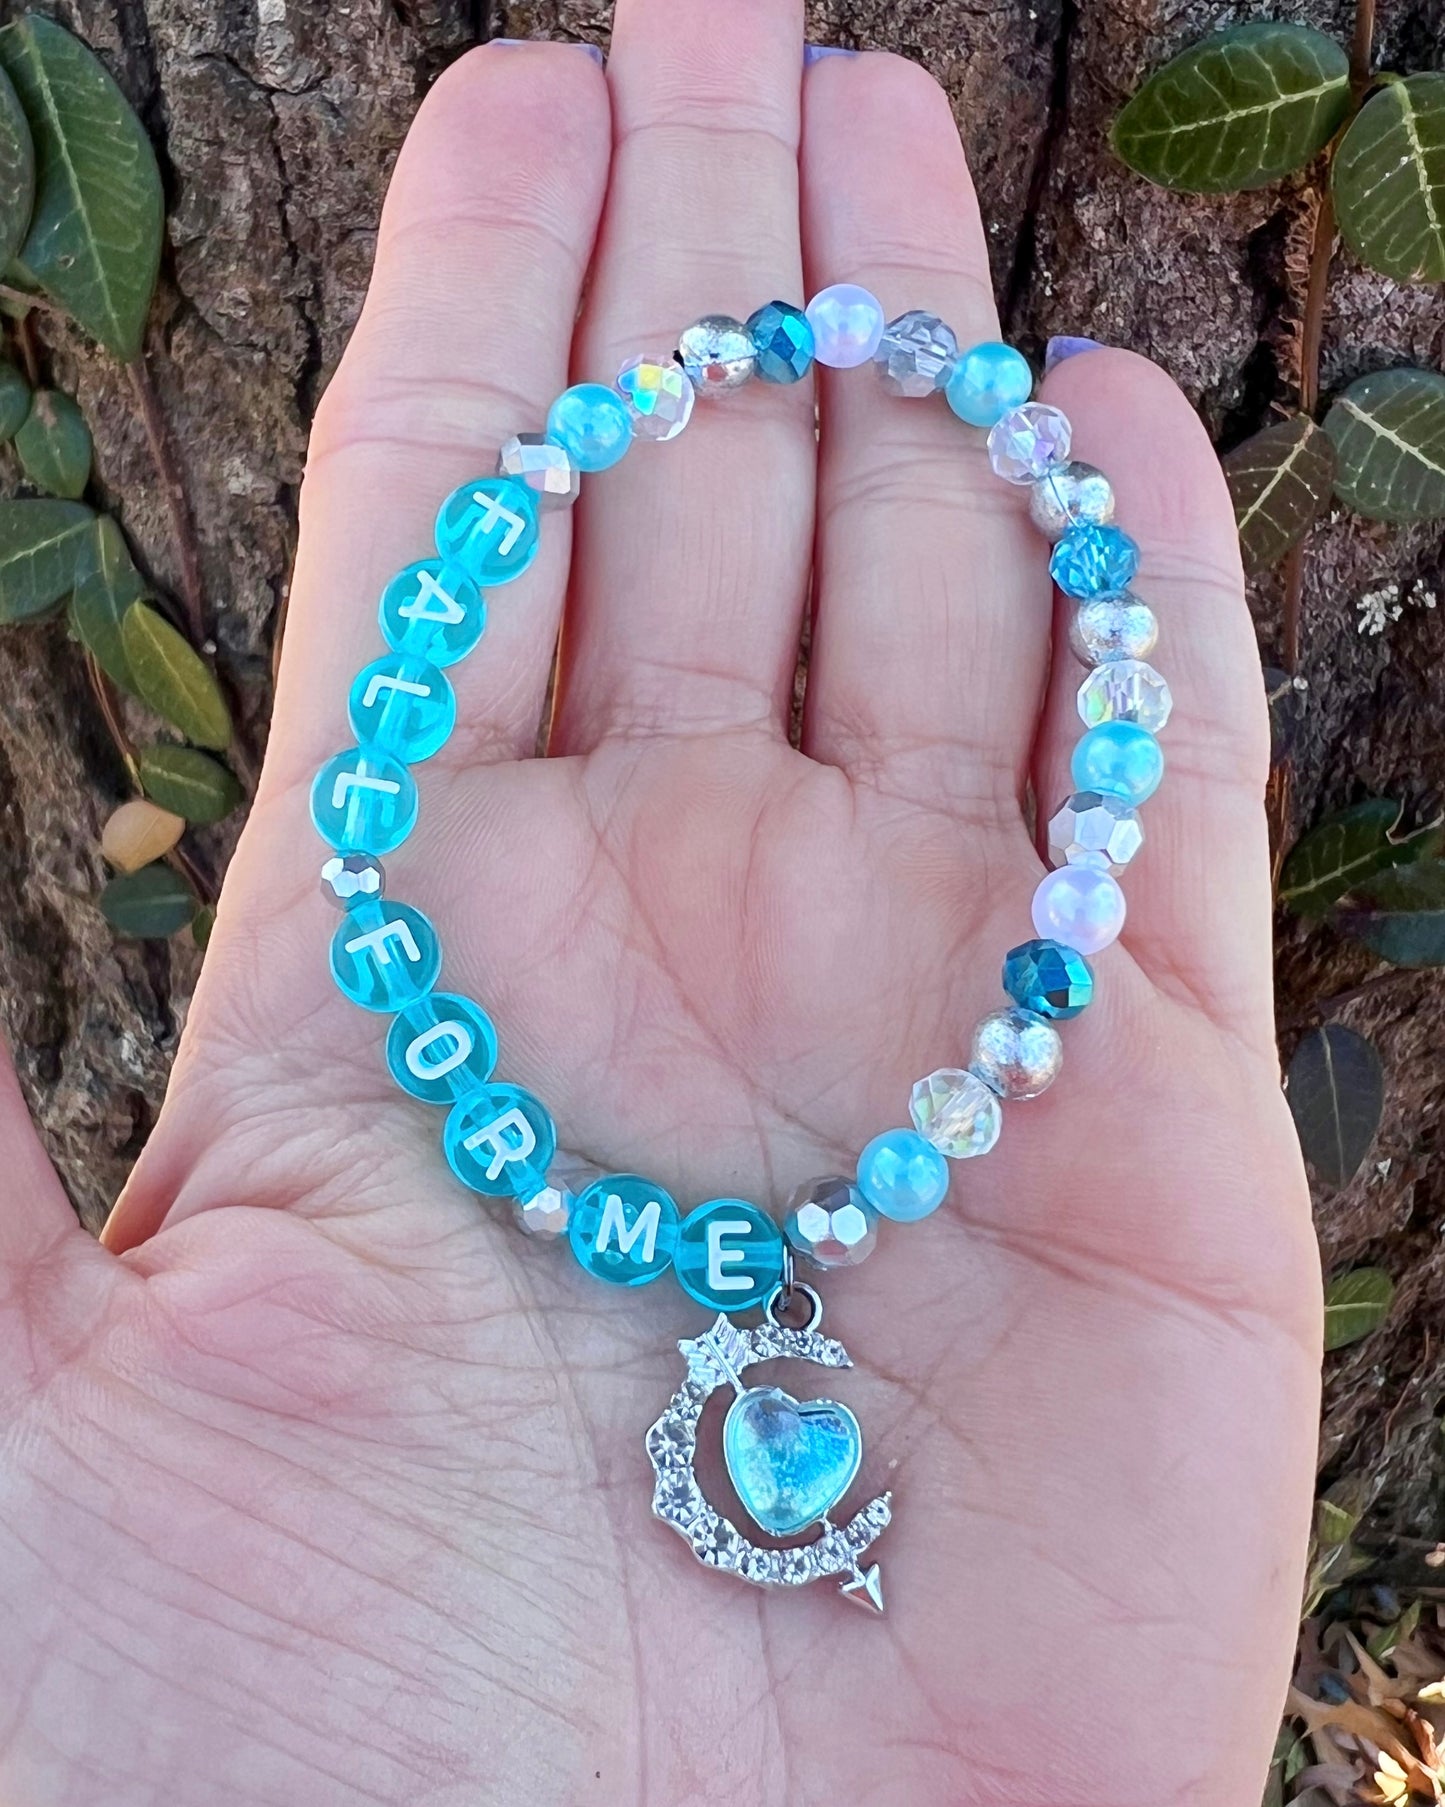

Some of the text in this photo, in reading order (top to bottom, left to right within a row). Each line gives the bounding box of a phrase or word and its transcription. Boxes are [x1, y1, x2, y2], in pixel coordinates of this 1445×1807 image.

[331, 491, 756, 1291] FALL FOR ME
